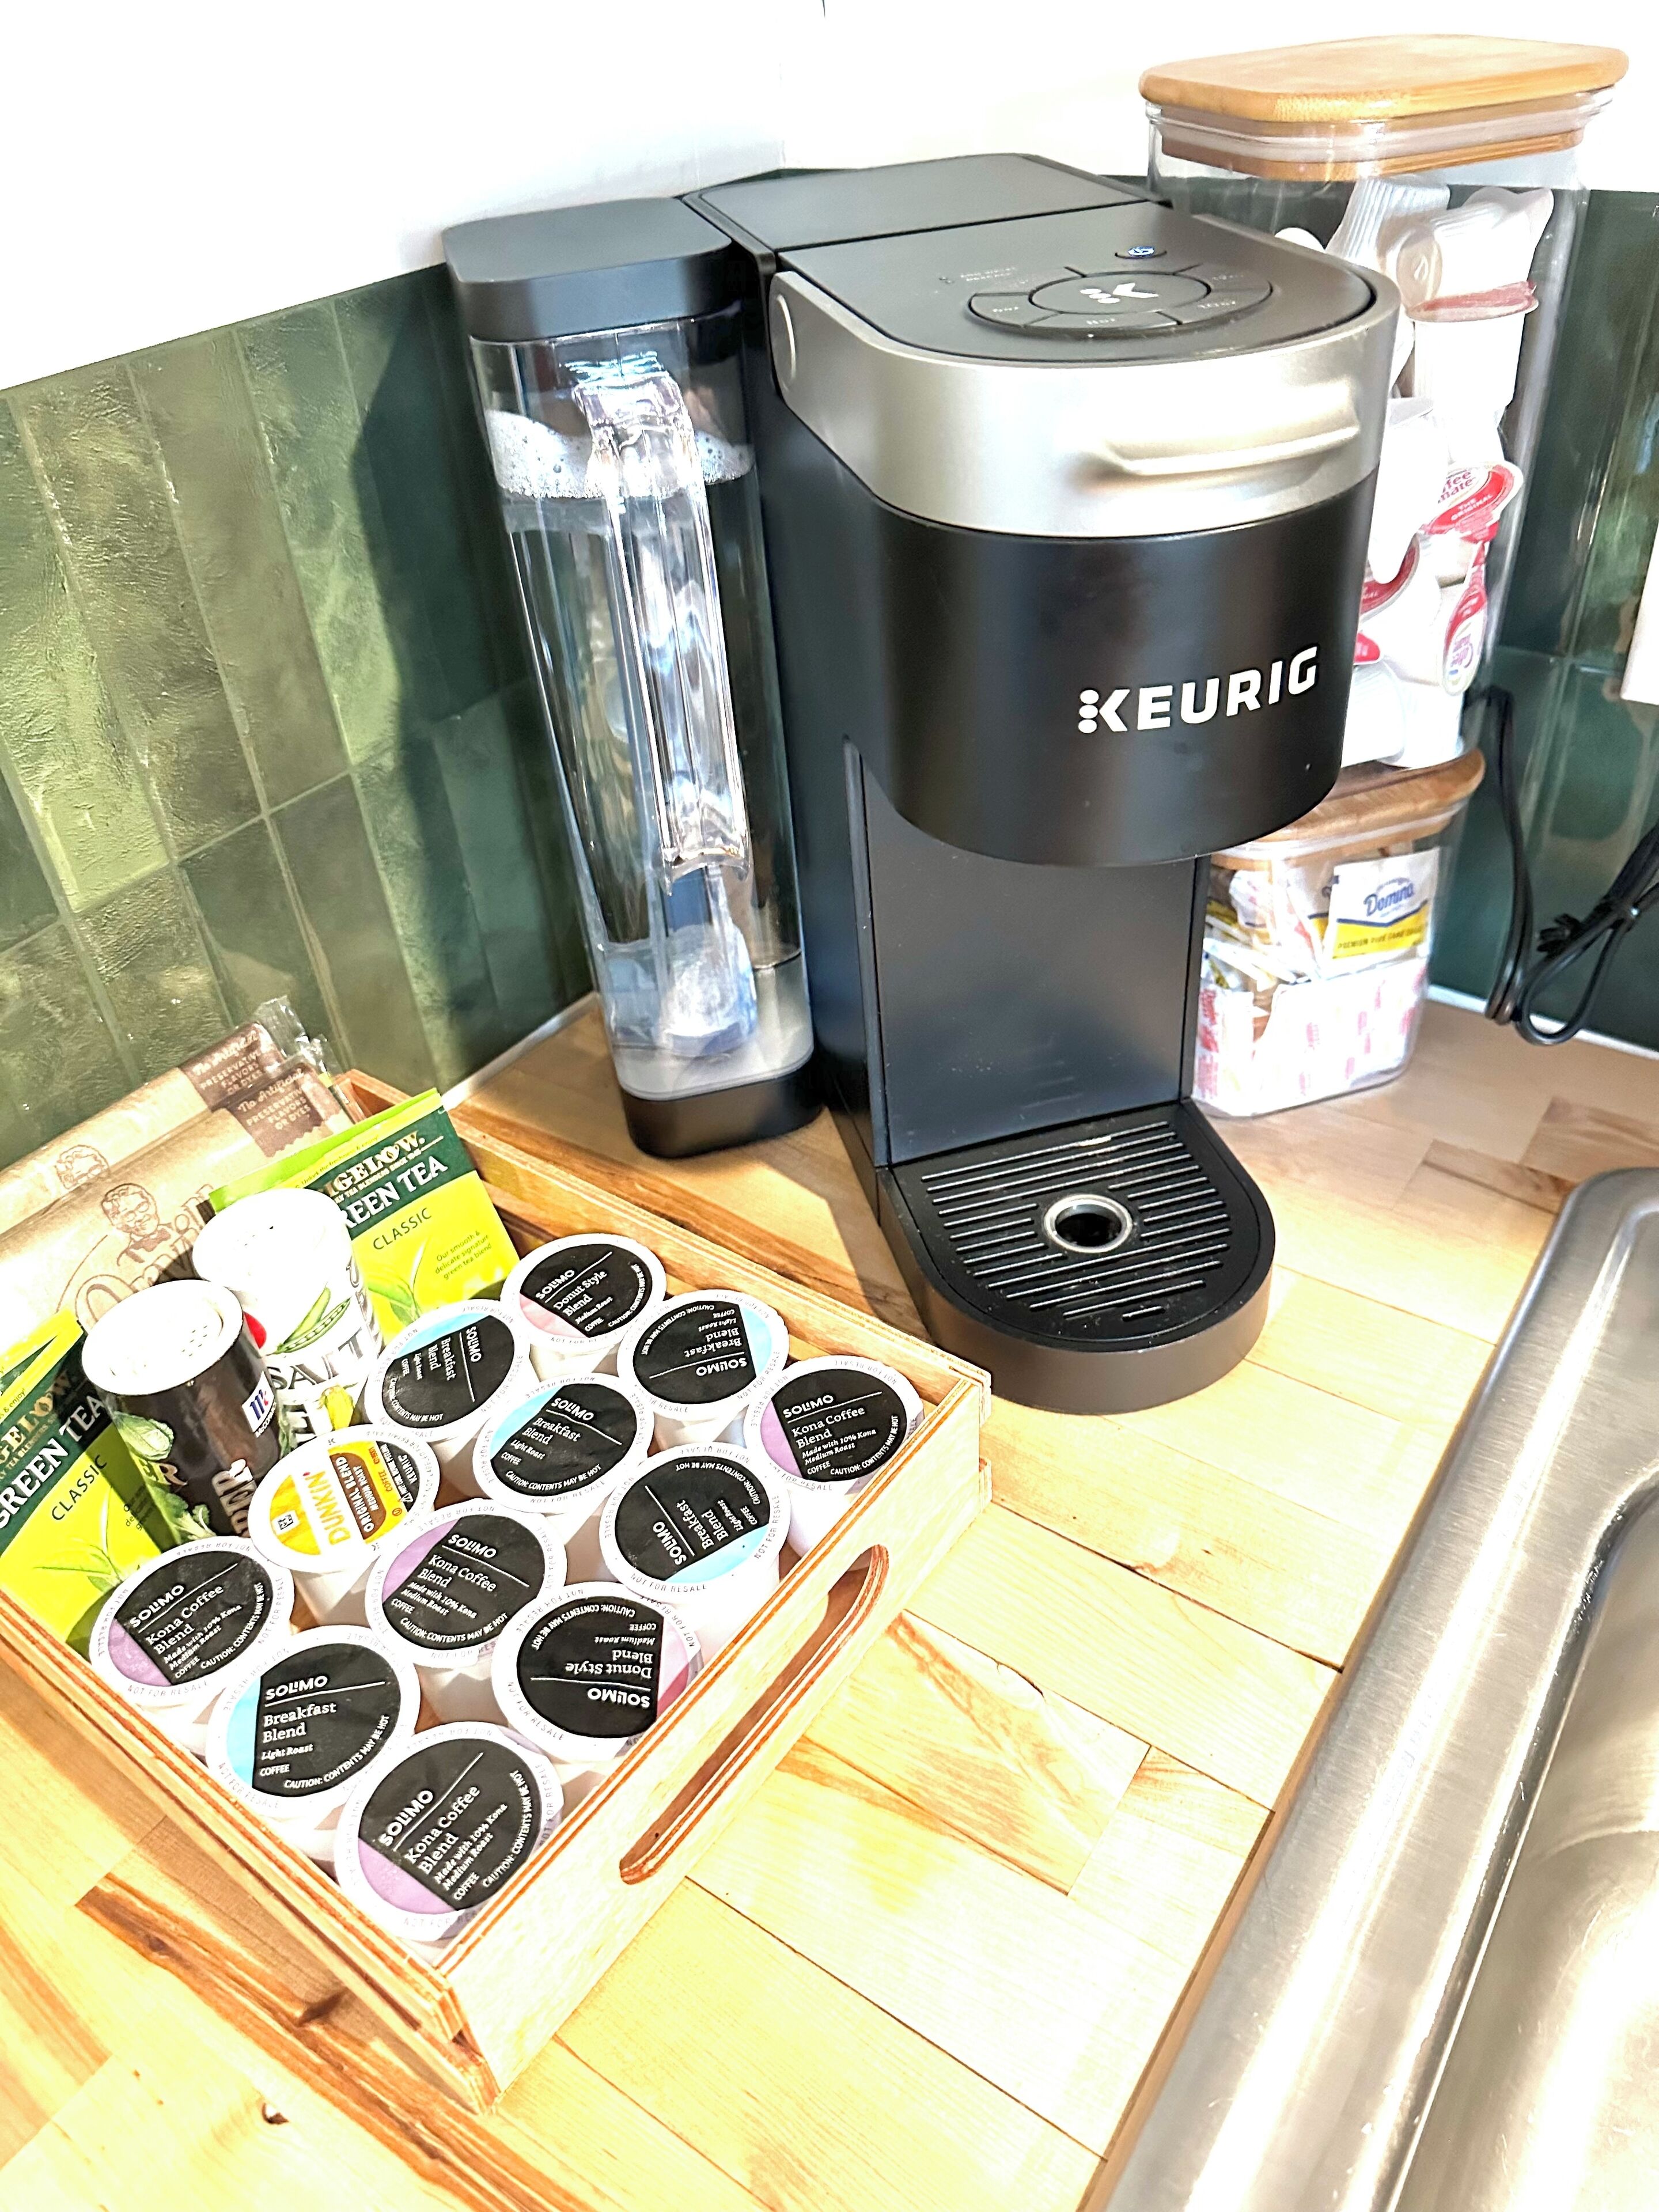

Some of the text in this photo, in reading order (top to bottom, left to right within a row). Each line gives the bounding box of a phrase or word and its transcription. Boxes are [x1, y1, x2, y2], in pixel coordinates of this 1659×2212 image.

[1449, 494, 1493, 521] ORIGINAL
[1078, 645, 1318, 734] KEURIG
[1362, 882, 1415, 916] Domino
[237, 1069, 304, 1114] No Artificial
[267, 1096, 307, 1124] FLAVORS
[274, 1103, 311, 1131] OR DYES
[339, 1155, 448, 1230] REEN TEA
[372, 1207, 431, 1251] CLASSIC
[434, 1234, 489, 1274] delicate signature
[435, 1251, 449, 1262] Our
[450, 1233, 475, 1253] smooth
[443, 1243, 492, 1280] green tea blend
[536, 1270, 574, 1299] SOLIMO
[554, 1272, 607, 1309] Donut Style
[563, 1294, 592, 1316] Blend
[713, 1309, 734, 1318] COFFEE
[585, 1317, 604, 1331] COFFEE
[706, 1328, 739, 1342] Blend
[429, 1344, 441, 1370] Blend
[441, 1338, 456, 1380] Breakfast
[466, 1327, 481, 1362] SOLIMO
[684, 1338, 741, 1357] Breakfast
[402, 1359, 410, 1377] COFFEE
[696, 1358, 747, 1376] SOLIMO
[2, 1406, 10, 1414] &
[551, 1398, 593, 1420] SOLIMO
[783, 1395, 834, 1418] SOLIMO
[522, 1427, 553, 1445] Blend
[533, 1418, 580, 1441] Breakfast
[791, 1408, 865, 1437] Kona Coffee
[510, 1440, 528, 1451] Light
[796, 1429, 832, 1449] Blend
[802, 1430, 876, 1459] Made with 10% Kona
[0, 1396, 107, 1529] GREEN TEA
[501, 1452, 521, 1465] COFFEE
[803, 1443, 855, 1465] Medium Roast
[808, 1461, 831, 1474] COFFEE
[831, 1464, 861, 1475] CAUTION:
[862, 1445, 889, 1468] CONTENTS
[49, 1454, 108, 1522] CLASSIC
[353, 1465, 379, 1511] MEDIUM ROAST
[377, 1469, 393, 1492] COFFEE
[506, 1471, 529, 1487] CAUTION:
[676, 1463, 760, 1504] CAUTION: CONTENTS HOT
[302, 1467, 351, 1546] DUNKIN'
[335, 1457, 374, 1532] ORIGINAL BLEND
[676, 1500, 714, 1549] Breakfast
[702, 1510, 728, 1541] Blend
[718, 1500, 743, 1531] Light Roast
[740, 1506, 757, 1525] COFFEE
[448, 1535, 496, 1558] SOLIMO
[653, 1522, 686, 1565] SOLIMO
[418, 1569, 452, 1588] Blend
[429, 1555, 496, 1592] Kona Coffee
[129, 1585, 184, 1627] SOLIMO
[391, 1599, 415, 1613] COFFEE
[401, 1589, 449, 1615] Medium Roast
[407, 1582, 477, 1619] Made with 10% Kona
[515, 1589, 583, 1634] NOT RESALE
[146, 1586, 224, 1645] Kona Coffee
[400, 1613, 507, 1643] CAUTION: CONTENTS HOT
[532, 1605, 635, 1650] CAUTION: CONTENTS HOT
[154, 1624, 195, 1654] Blend
[164, 1605, 241, 1664] Made with 10% Kona
[169, 1626, 221, 1671] Medium Roast
[621, 1637, 655, 1645] Medium
[175, 1656, 200, 1678] COFFEE
[200, 1646, 236, 1669] CAUTION:
[566, 1662, 652, 1679] Donut Style
[612, 1650, 653, 1664] Blend
[266, 1676, 327, 1700] SOLIMO
[588, 1688, 650, 1707] SOLIMO
[264, 1703, 336, 1727] Breakfast
[263, 1722, 306, 1743] Blend
[262, 1744, 313, 1760] Light Roast
[284, 1715, 389, 1789] CAUTION: CONTENTS HOT
[259, 1764, 289, 1777] COFFEE
[378, 1791, 433, 1846] SOLIMO
[403, 1787, 480, 1864] Kona Coffee
[511, 1811, 532, 1854] CONTENTS
[417, 1833, 459, 1874] Blend
[433, 1804, 507, 1884] Made with 10% Kona
[440, 1833, 493, 1891] Medium Roast
[453, 1872, 479, 1900] COFFEE
